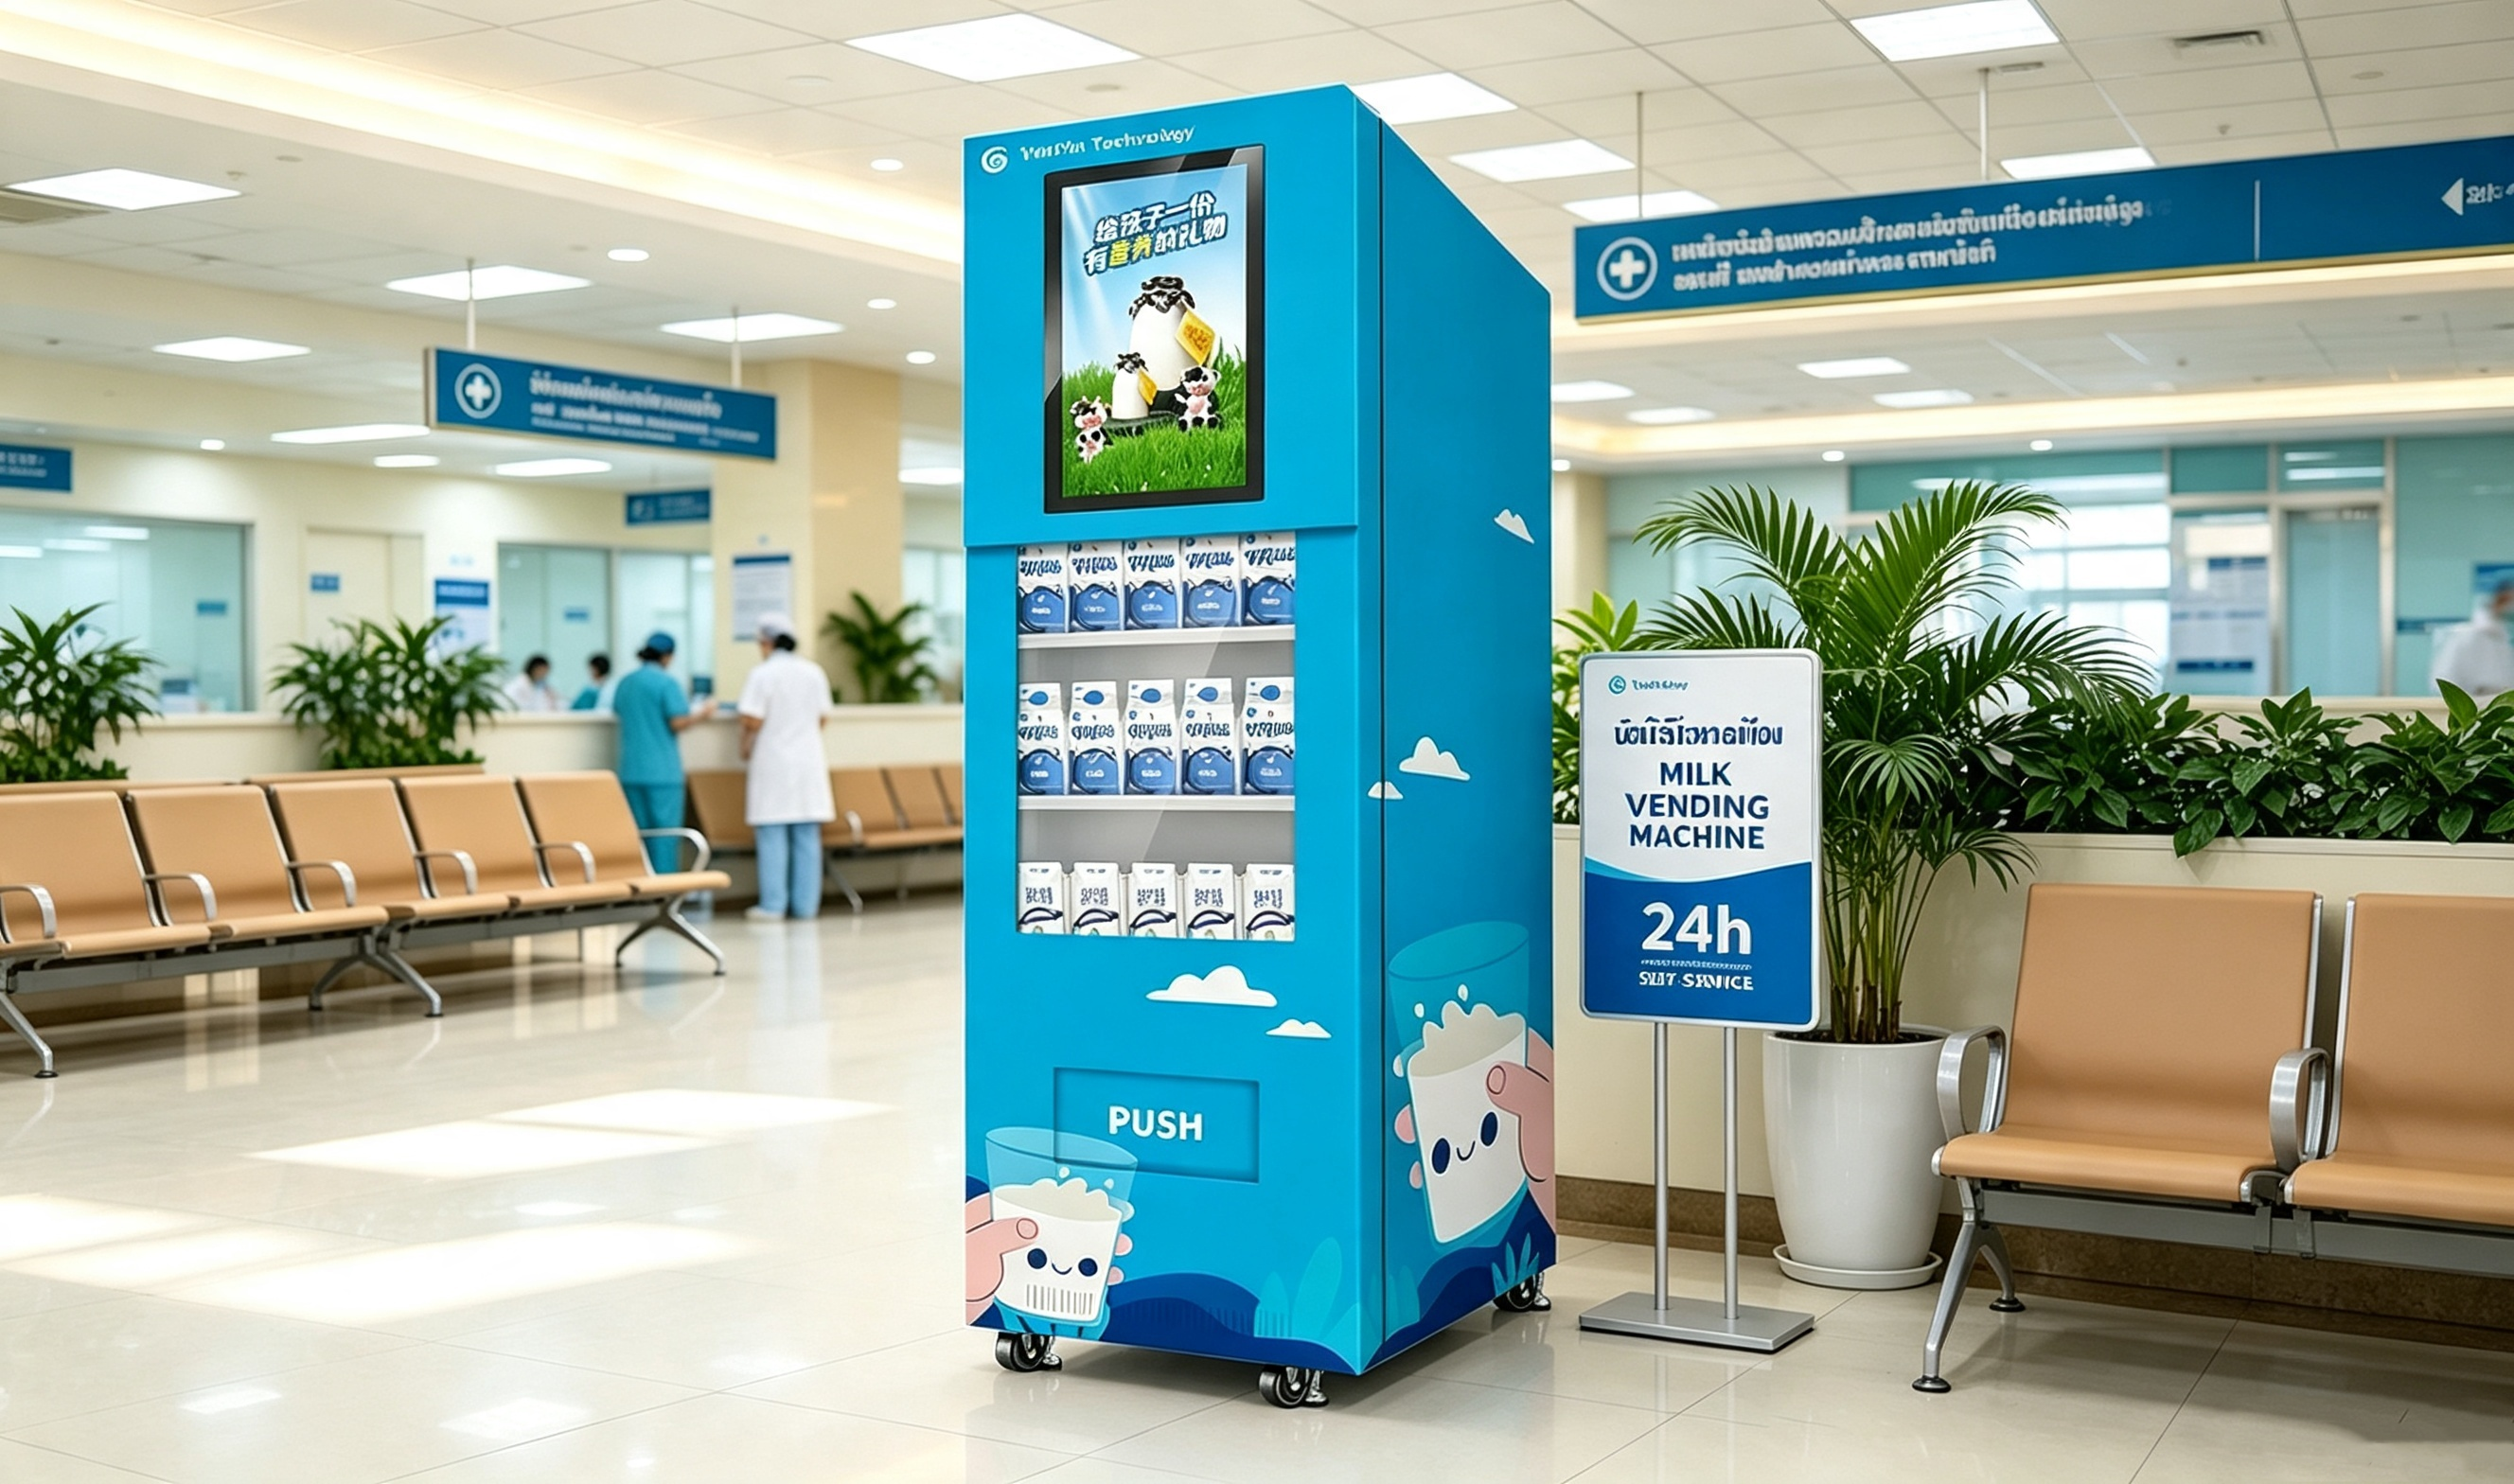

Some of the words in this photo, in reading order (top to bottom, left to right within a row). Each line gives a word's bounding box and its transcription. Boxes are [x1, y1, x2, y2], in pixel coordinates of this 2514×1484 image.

[1659, 761, 1732, 787] MILK
[1624, 792, 1770, 821] VENDING
[1629, 823, 1765, 850] MACHINE
[1641, 901, 1751, 955] 24h
[1108, 1105, 1203, 1141] PUSH
